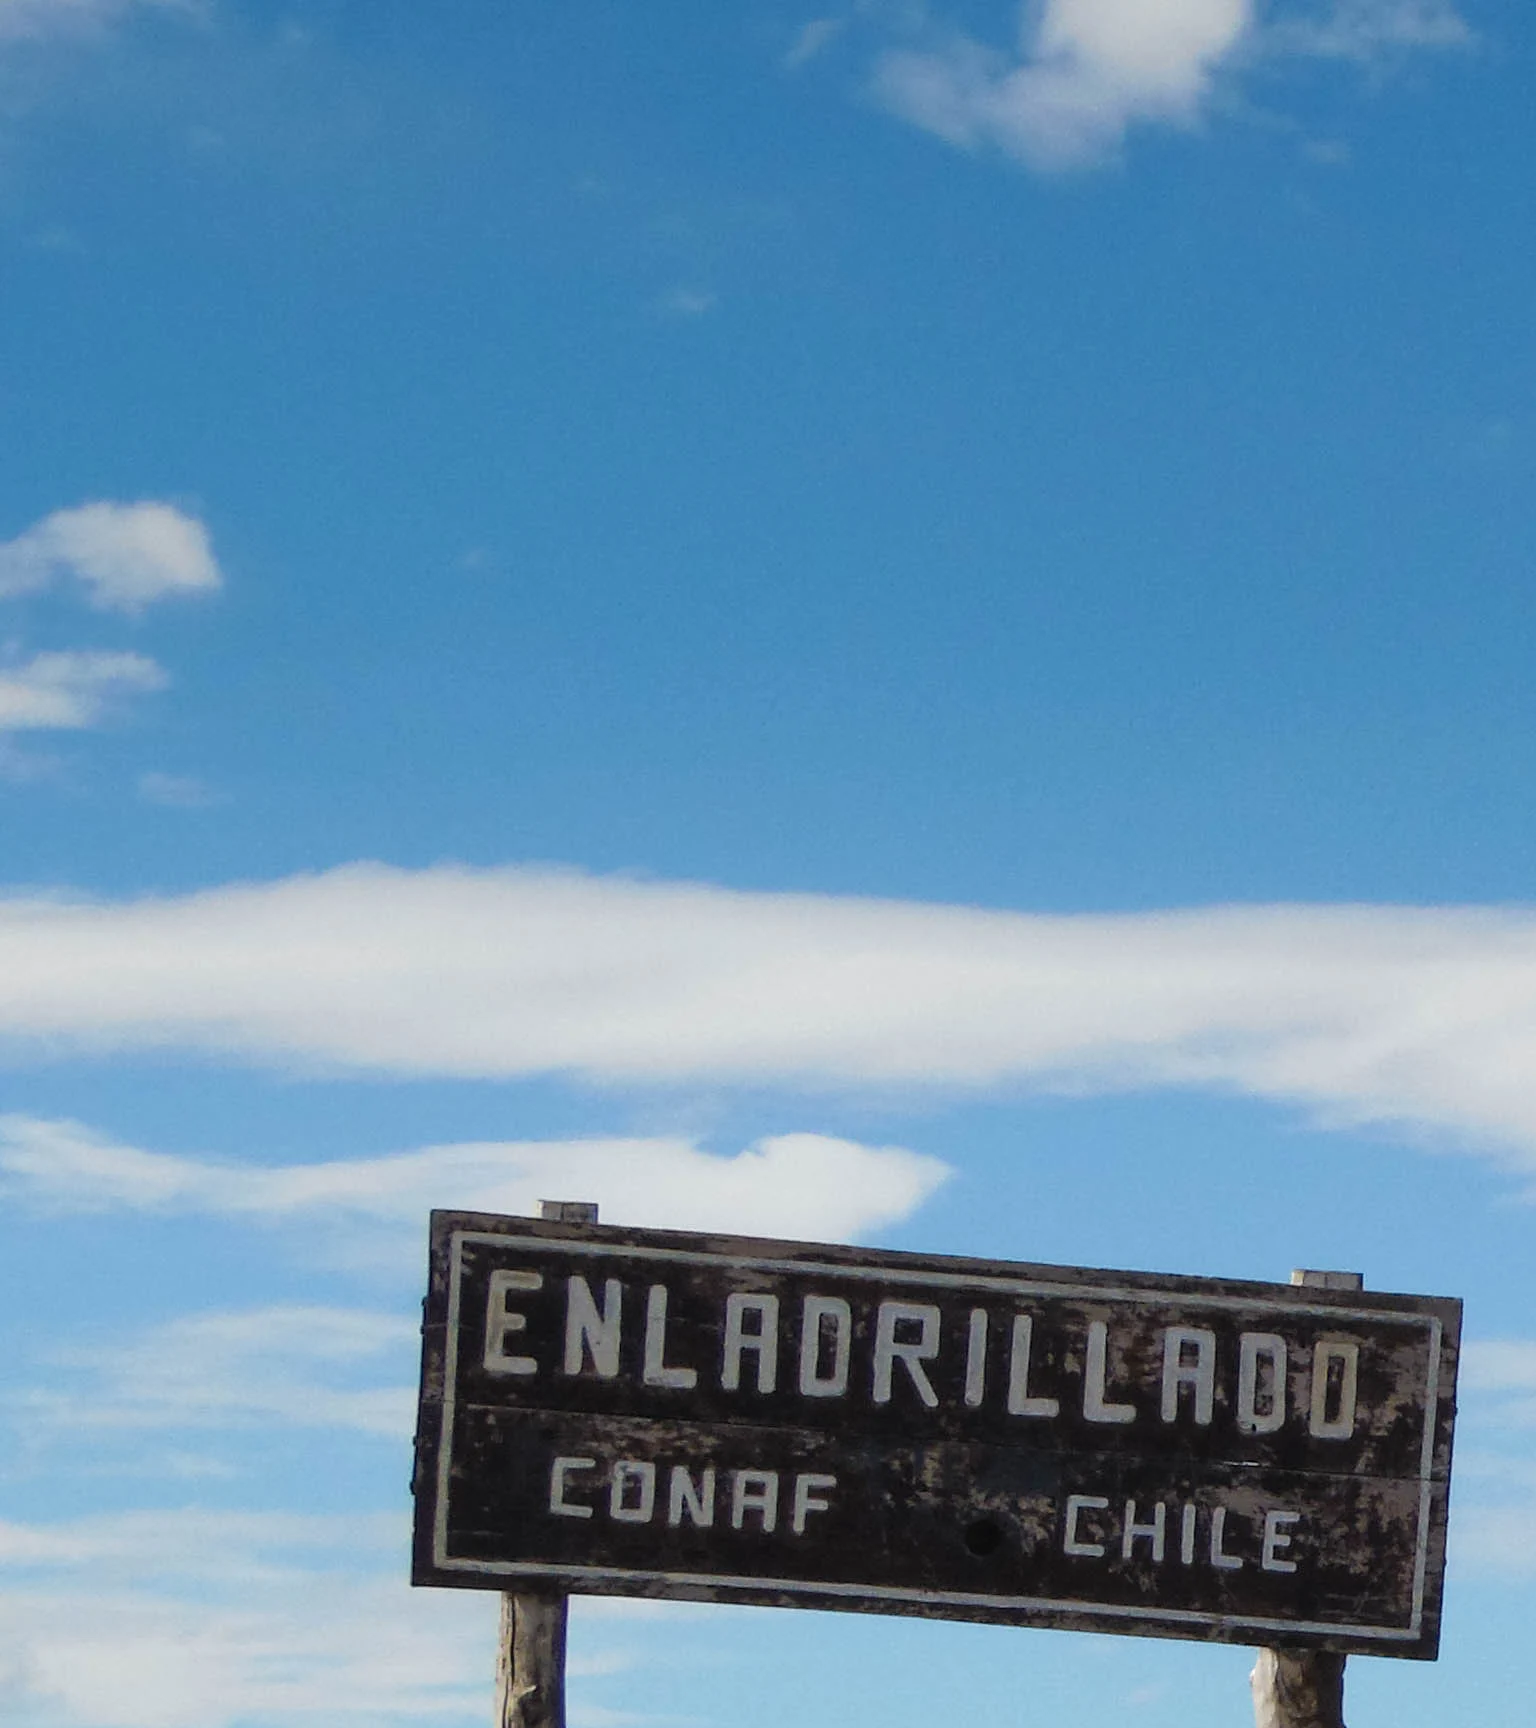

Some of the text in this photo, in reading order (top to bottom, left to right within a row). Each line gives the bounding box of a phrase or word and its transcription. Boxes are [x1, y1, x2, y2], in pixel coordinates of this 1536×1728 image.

[483, 1269, 1358, 1440] ENLADRILLADO
[549, 1456, 1301, 1574] CONAF CHILE
